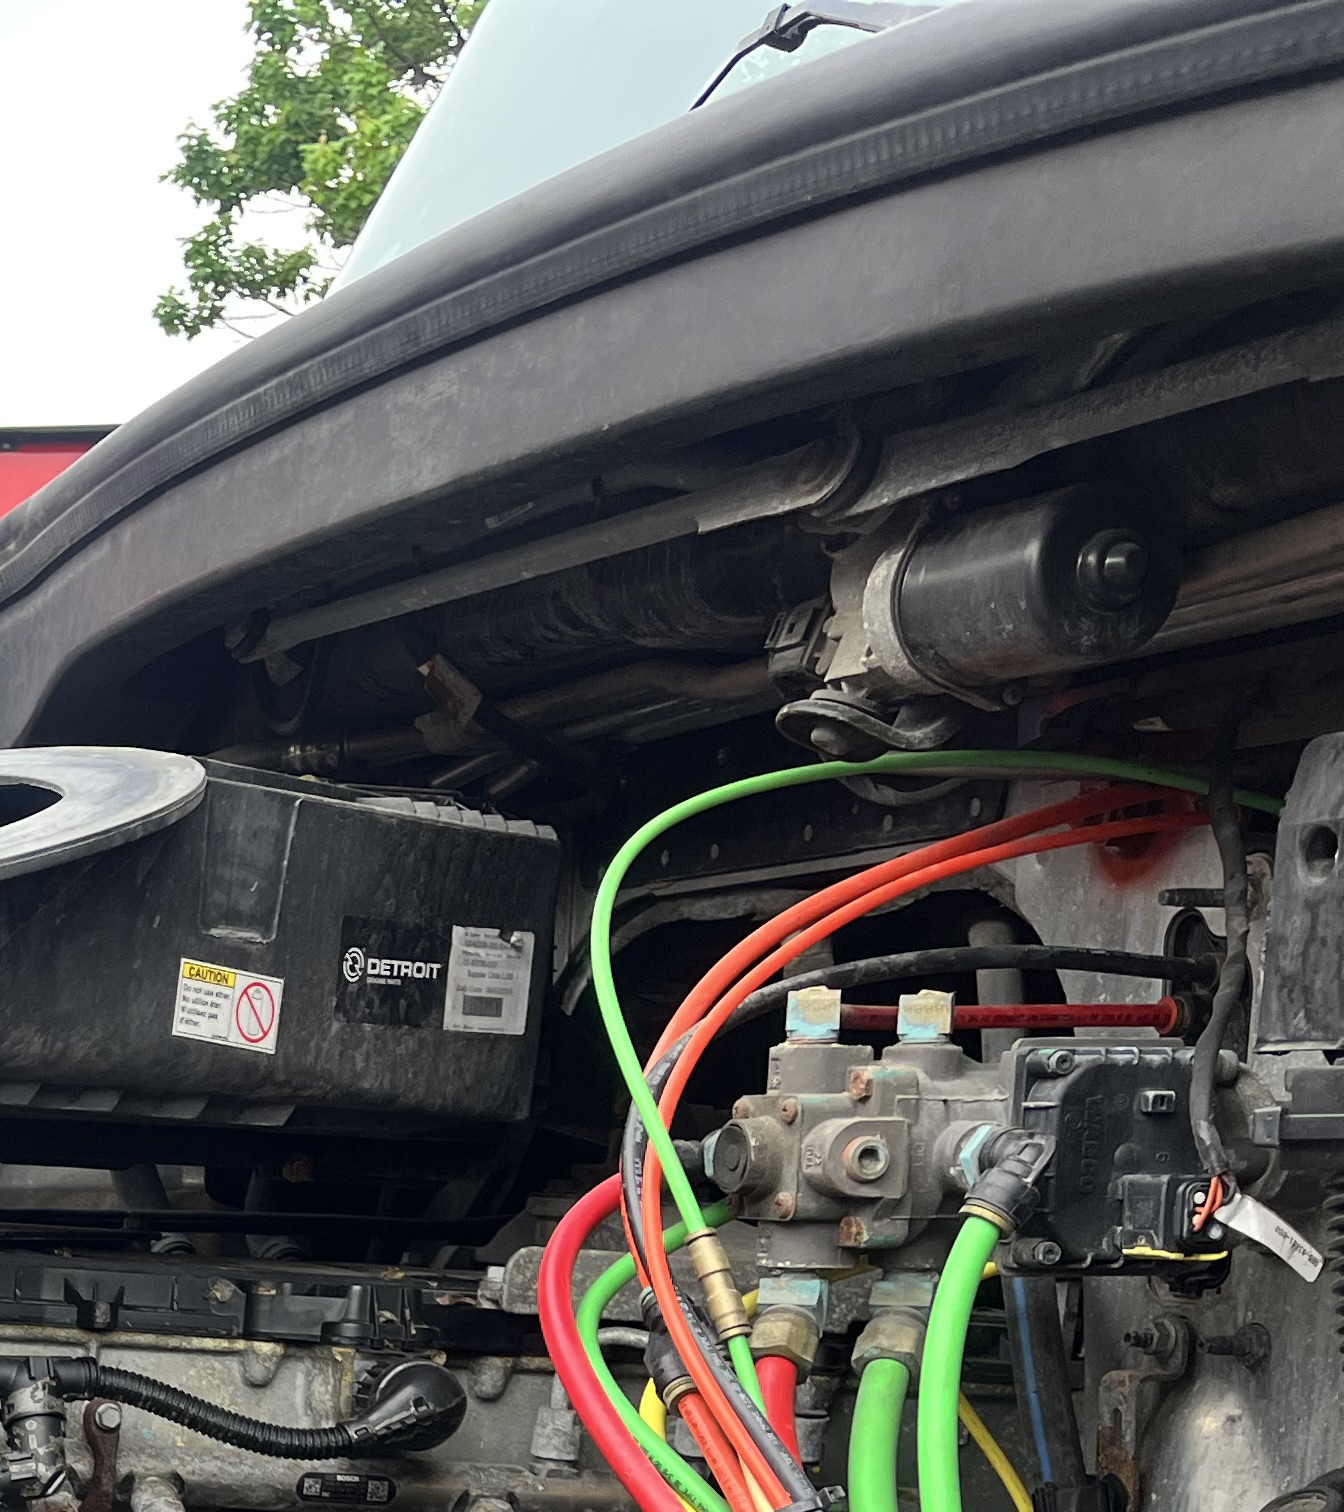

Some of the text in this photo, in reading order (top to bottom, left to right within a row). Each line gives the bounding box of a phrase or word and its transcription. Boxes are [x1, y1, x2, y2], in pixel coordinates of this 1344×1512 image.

[188, 966, 229, 984] CAUTION
[366, 958, 442, 979] DETROIT
[183, 983, 192, 991] Do
